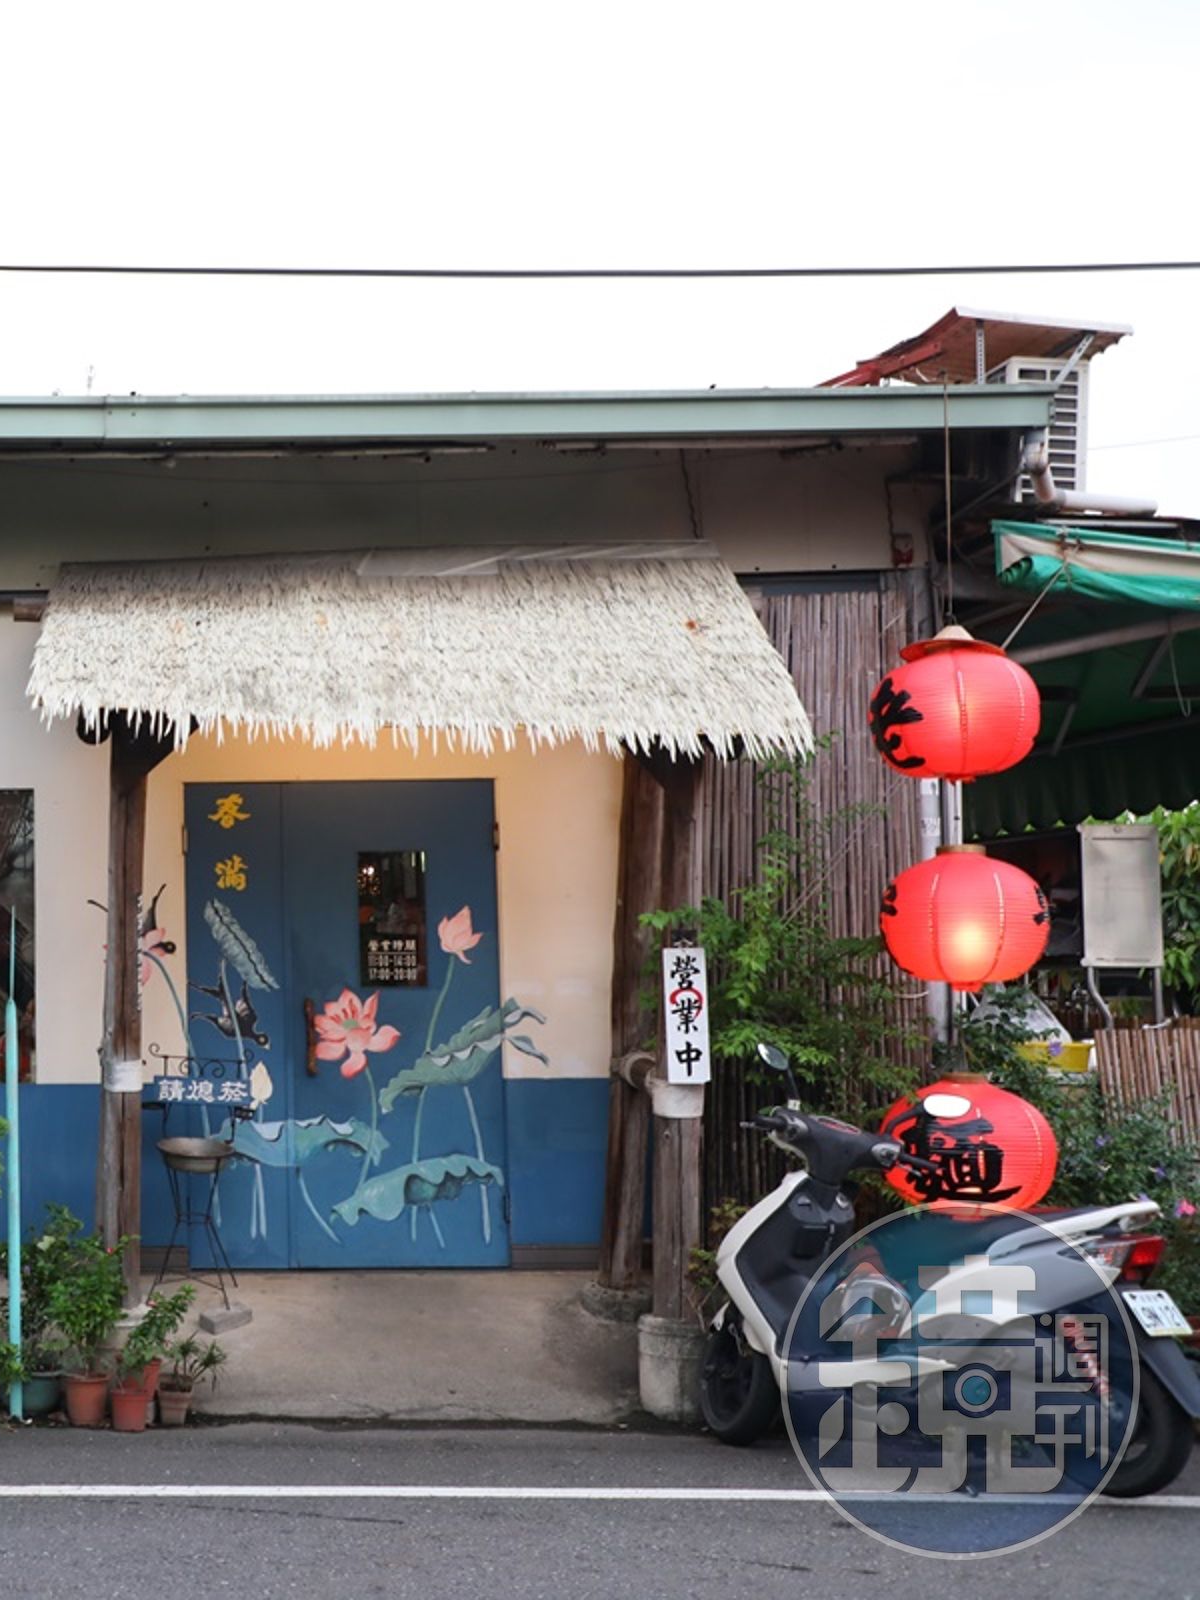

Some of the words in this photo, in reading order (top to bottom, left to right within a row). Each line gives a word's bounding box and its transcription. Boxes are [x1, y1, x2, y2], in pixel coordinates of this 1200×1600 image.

[669, 954, 703, 1077] 營業中
[157, 1079, 249, 1103] 請熄菸
